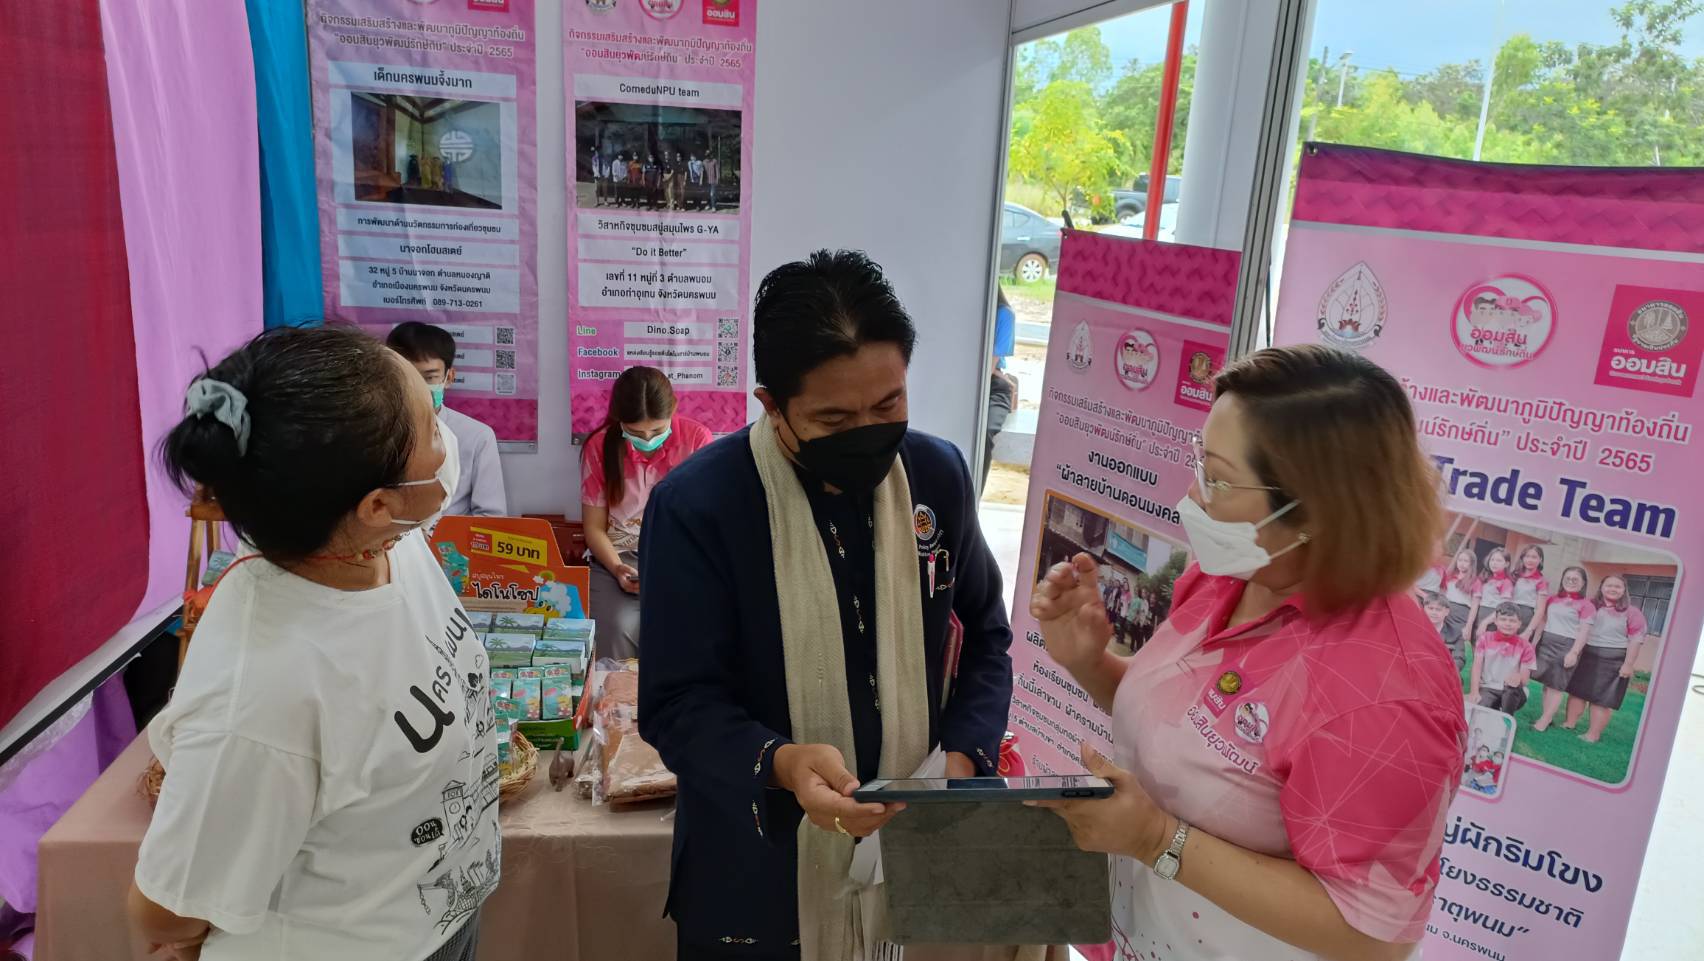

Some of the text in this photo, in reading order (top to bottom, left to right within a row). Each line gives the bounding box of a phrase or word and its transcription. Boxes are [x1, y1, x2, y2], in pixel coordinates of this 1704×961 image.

[489, 46, 513, 58] 2565
[719, 58, 741, 68] 2565
[619, 83, 700, 97] ComeduNPU team
[696, 225, 719, 235] G-YA
[651, 248, 657, 257] it
[628, 273, 637, 282] 11
[660, 274, 665, 283] 3
[433, 299, 482, 308] 089-713-0261
[577, 326, 596, 335] Line
[577, 347, 618, 357] Facebook
[1610, 355, 1687, 378] ออมสิน
[578, 370, 621, 380] Instagram
[1516, 431, 1588, 461] ประจำปี
[1599, 447, 1652, 473] 2565
[1088, 450, 1159, 486] งานออกแบบ
[1430, 454, 1677, 539] Trade Team
[497, 541, 513, 555] 59
[516, 546, 540, 560] บาท
[1433, 895, 1530, 938] าตุพนม”
